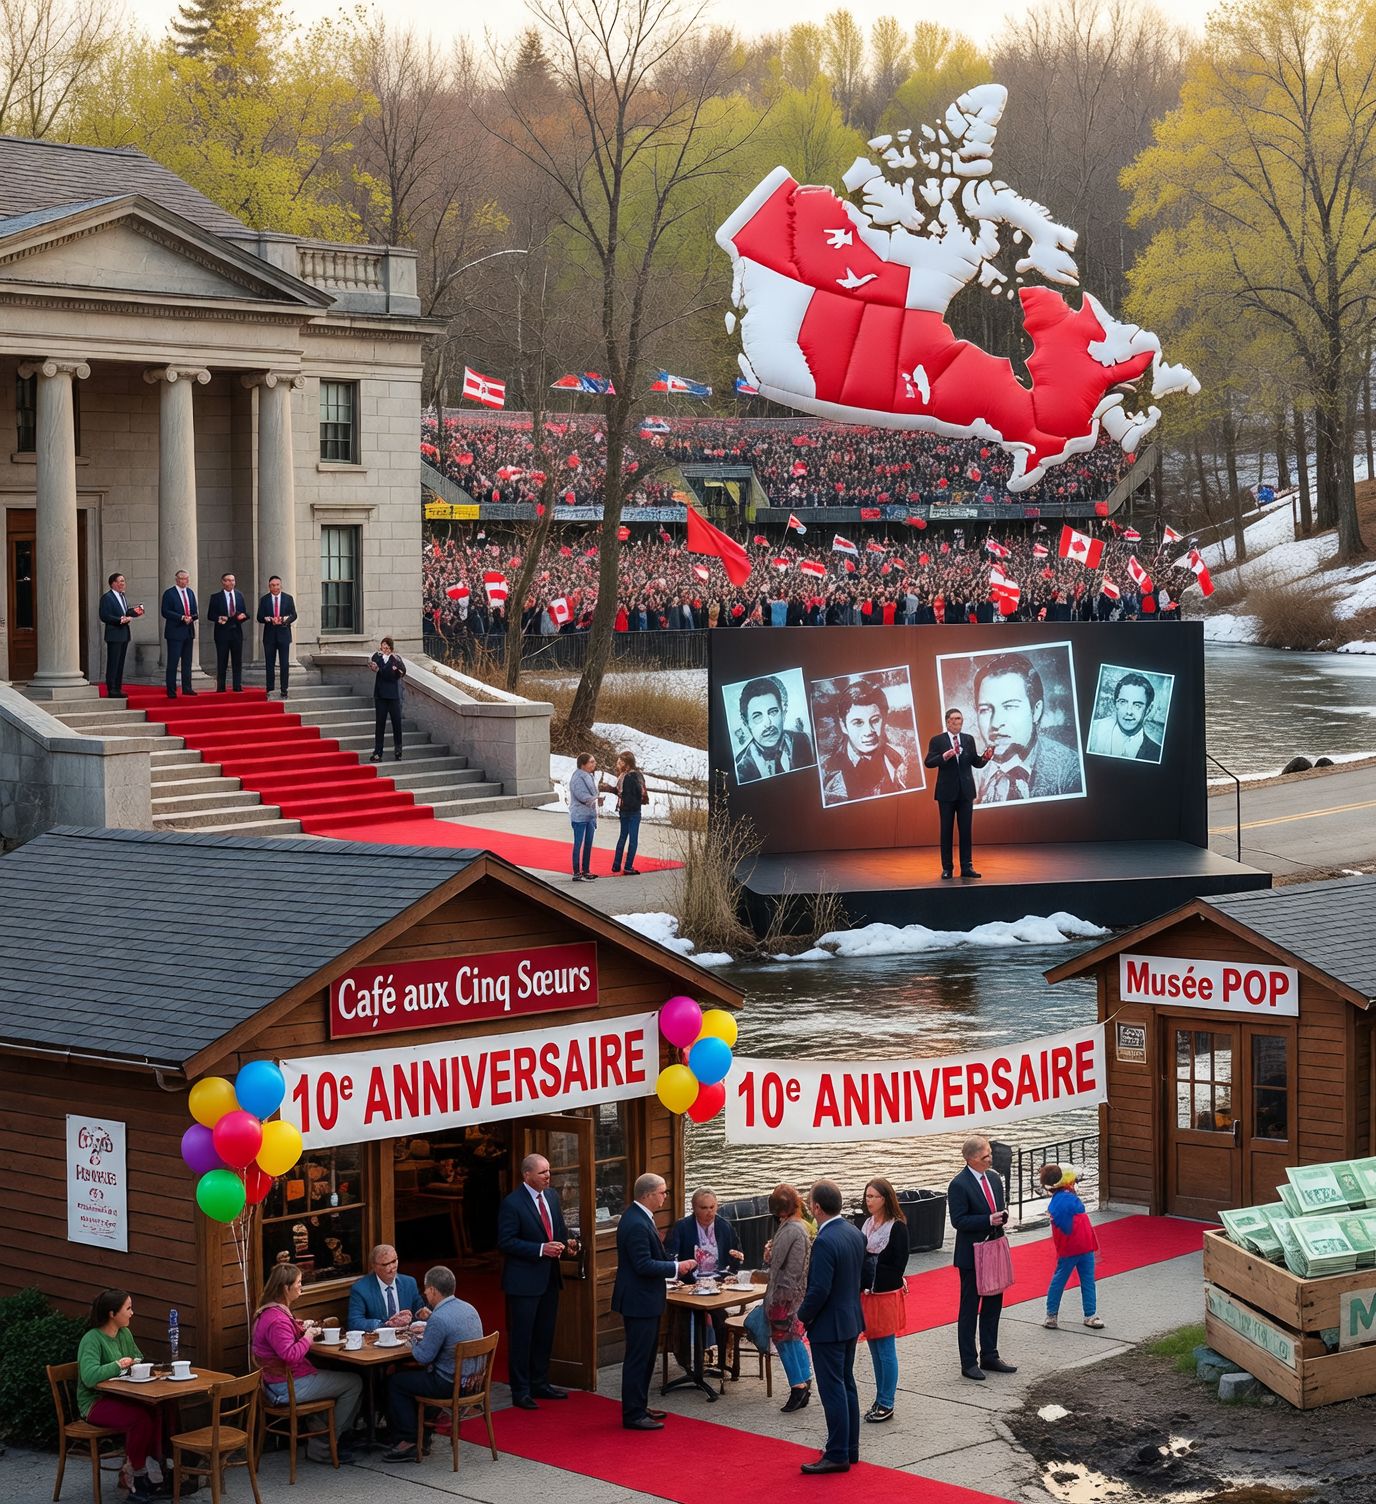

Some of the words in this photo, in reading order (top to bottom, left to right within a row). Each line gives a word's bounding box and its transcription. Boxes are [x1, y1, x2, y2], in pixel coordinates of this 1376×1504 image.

[338, 975, 396, 1027] Café
[403, 979, 450, 1014] aux
[455, 965, 511, 1011] Cinq
[517, 959, 591, 999] Sœurs
[1127, 960, 1215, 1001] Musée
[1223, 968, 1290, 1007] POP
[363, 1029, 646, 1125] ANNIVERSAIRE
[812, 1039, 1097, 1128] ANNIVERSAIRE
